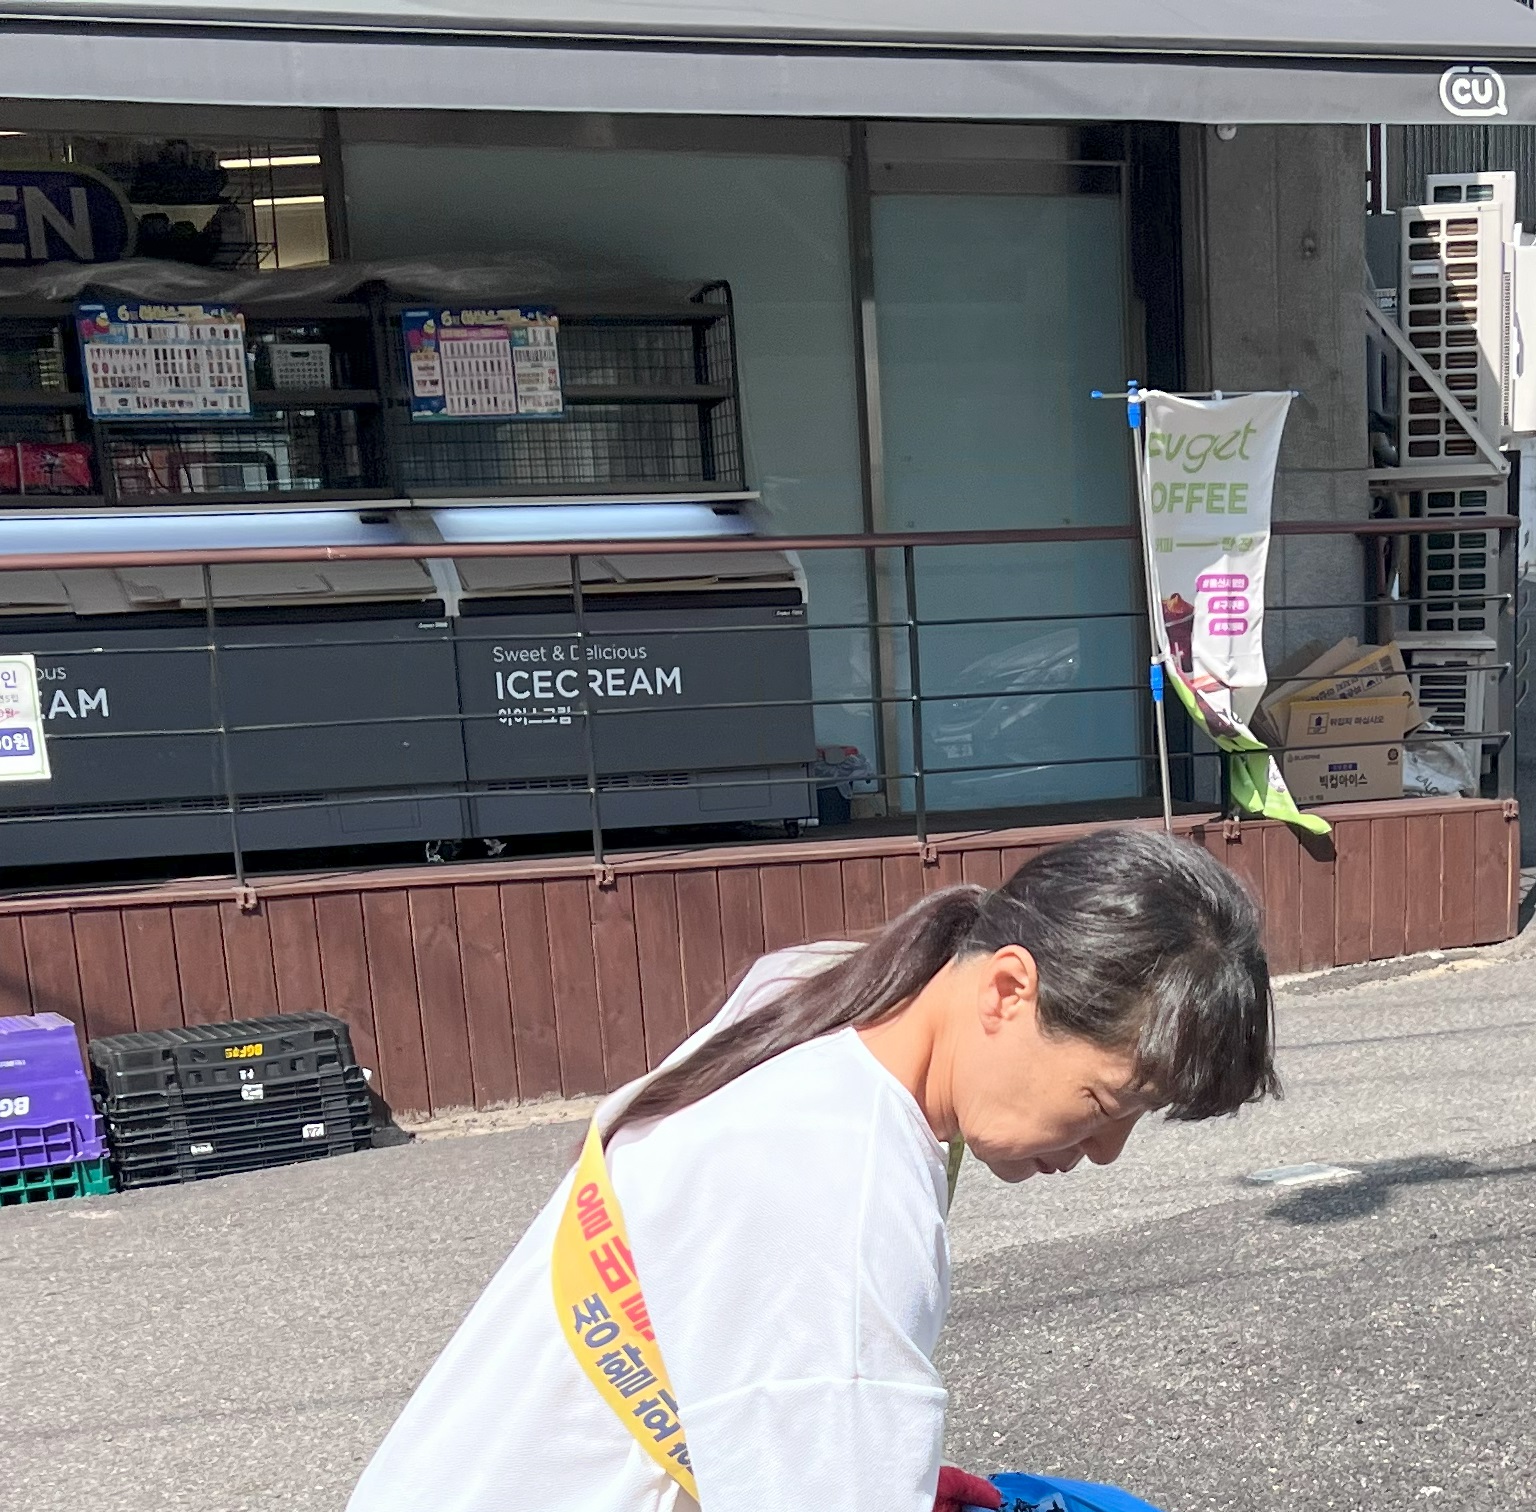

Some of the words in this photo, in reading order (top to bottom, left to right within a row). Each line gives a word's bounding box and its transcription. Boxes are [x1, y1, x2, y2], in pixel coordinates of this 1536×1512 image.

[1452, 78, 1493, 104] CU
[493, 646, 547, 662] Sweet
[552, 646, 565, 660] &
[495, 666, 683, 700] ICECREAM
[0, 732, 30, 752] 0원
[1319, 773, 1368, 789] 빅컵아이스
